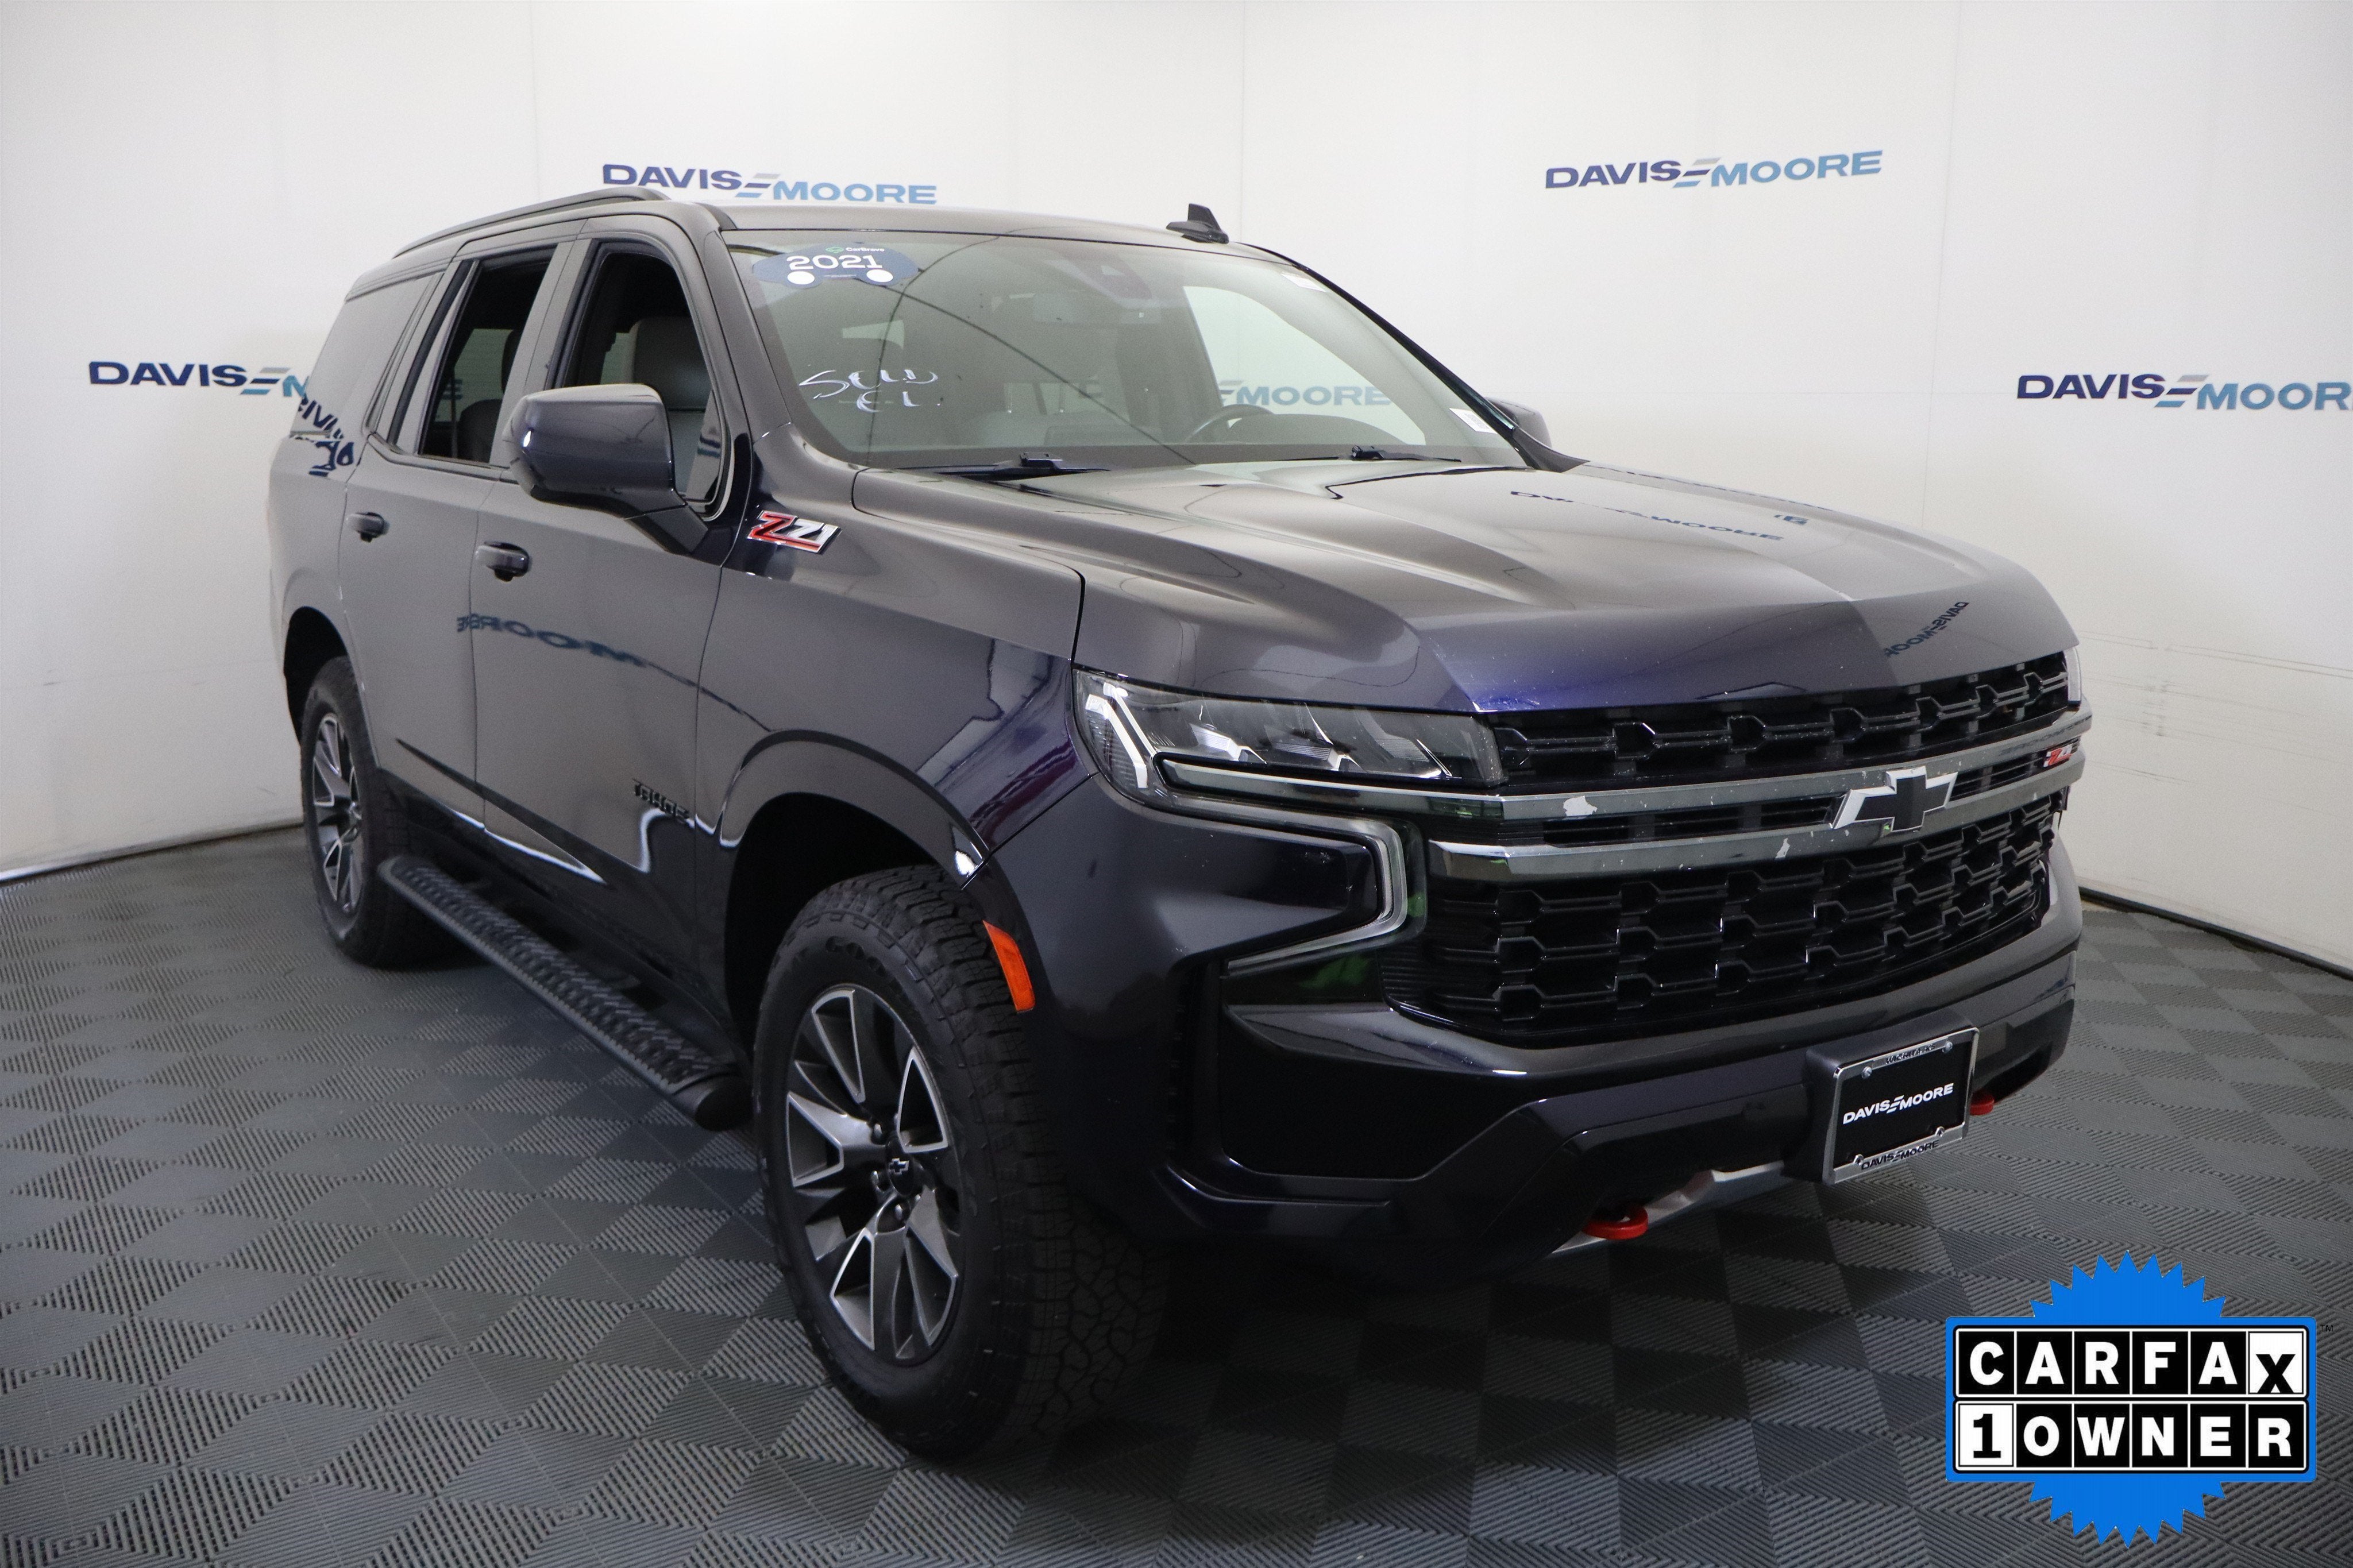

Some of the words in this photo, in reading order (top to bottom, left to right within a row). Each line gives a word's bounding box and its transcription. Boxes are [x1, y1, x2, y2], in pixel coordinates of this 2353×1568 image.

[603, 164, 742, 190] DAVIS
[773, 181, 937, 204] MOORE
[1545, 160, 1681, 188] DAVIS
[1711, 150, 1883, 187] MOORE
[786, 254, 883, 270] 2021
[89, 361, 246, 387] DAVIS
[1236, 386, 1391, 405] MOORE
[2016, 373, 2166, 399] DAVIS
[2196, 381, 2353, 410] MOOR
[1843, 1099, 1890, 1125] DAVIS
[1899, 1083, 1954, 1110] MOORE
[1861, 1153, 1895, 1170] DAVIS
[1900, 1140, 1939, 1159] MOORE
